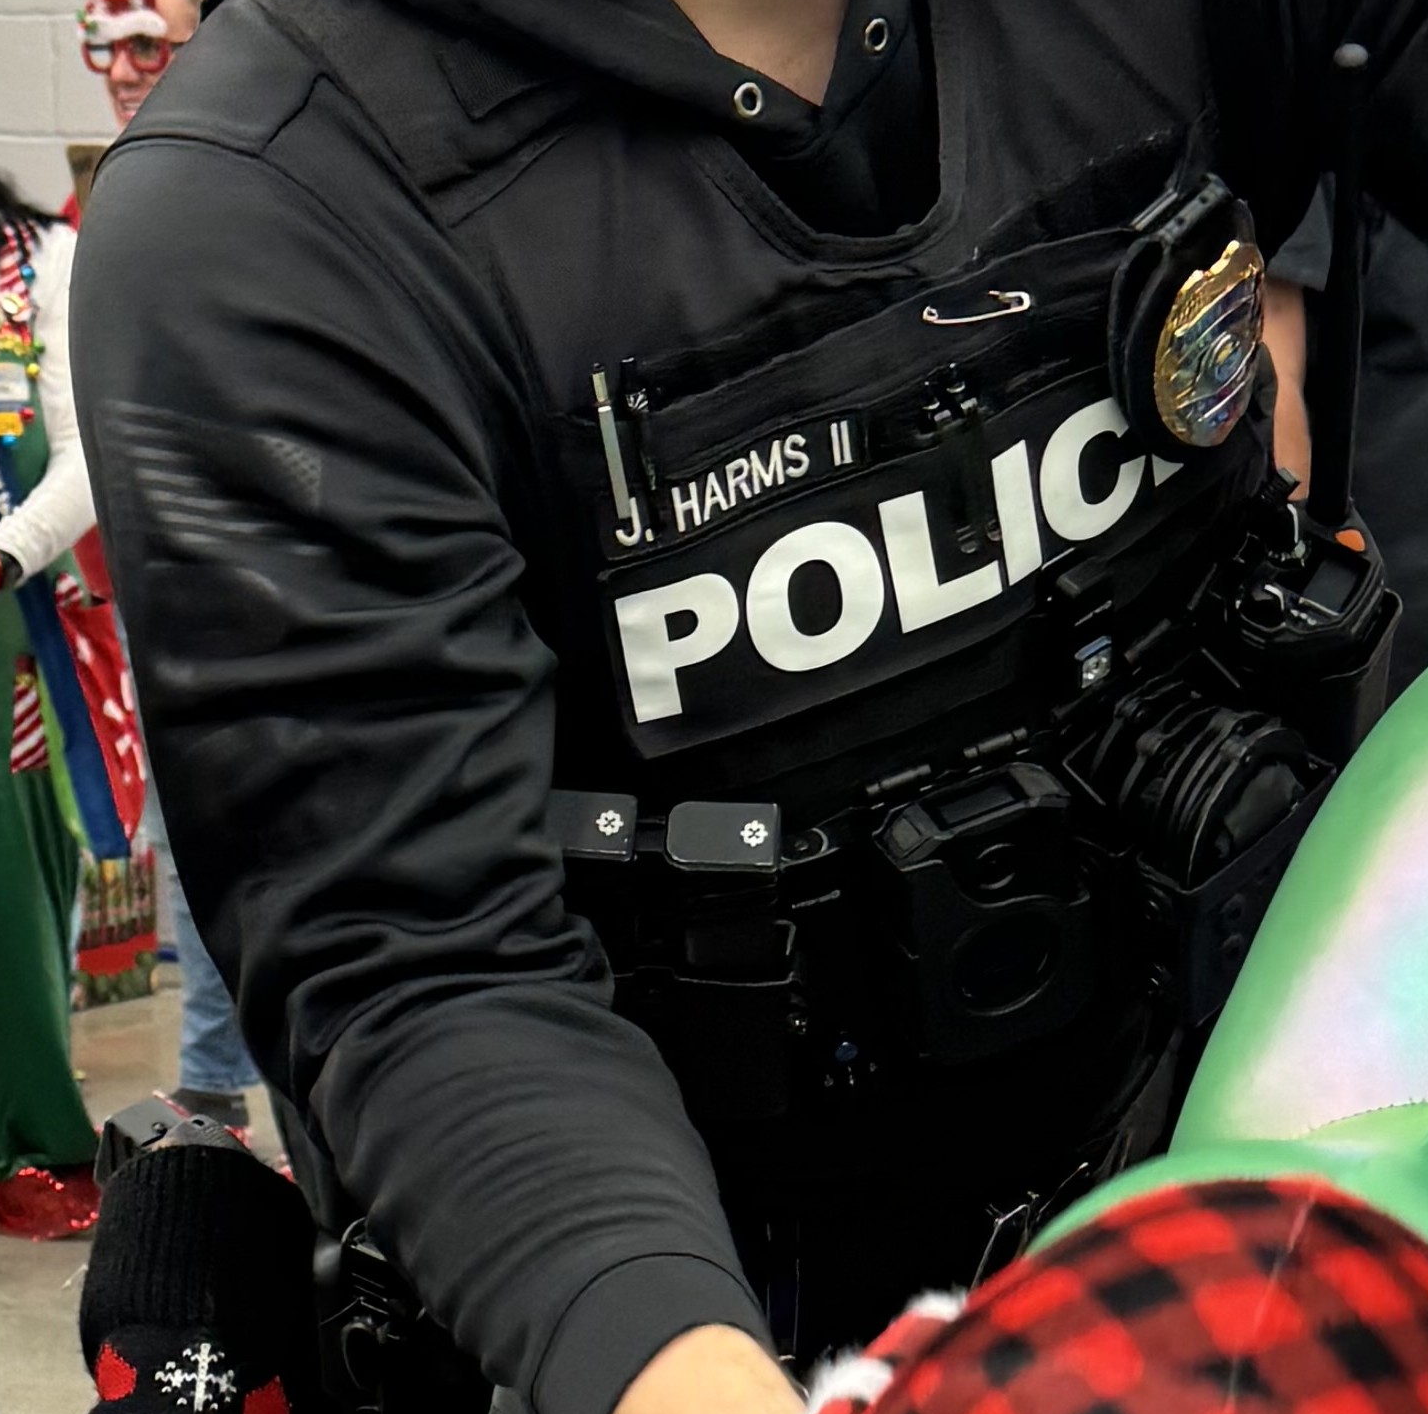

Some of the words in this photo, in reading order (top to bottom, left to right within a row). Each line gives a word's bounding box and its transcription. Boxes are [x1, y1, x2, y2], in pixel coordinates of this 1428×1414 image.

[615, 500, 654, 548] J.
[672, 433, 810, 535] HARMS
[830, 421, 853, 467] II
[615, 397, 1185, 723] POLIC
